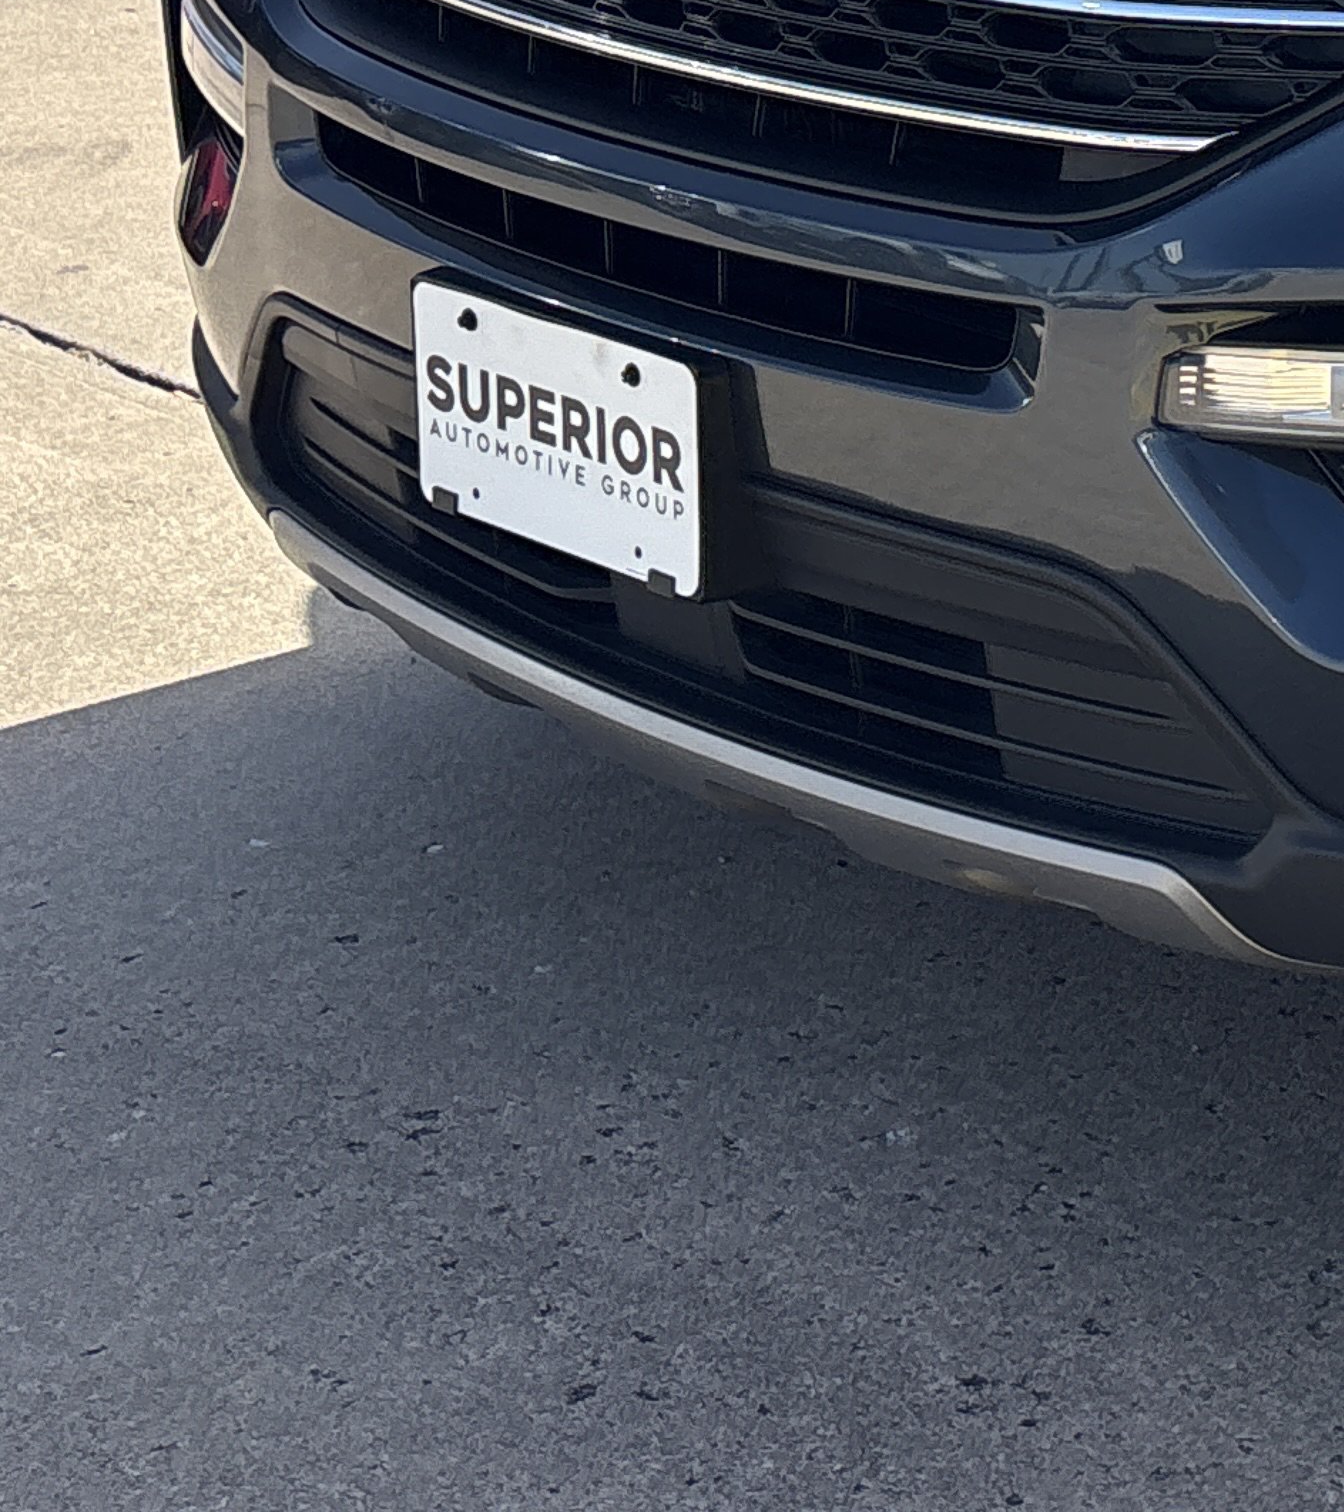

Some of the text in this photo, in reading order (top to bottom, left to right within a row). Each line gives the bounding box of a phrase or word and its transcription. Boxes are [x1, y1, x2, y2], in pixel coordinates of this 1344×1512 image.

[426, 354, 685, 494] SUPERIOR
[429, 418, 685, 520] AUTOMOTIVE GROUP
